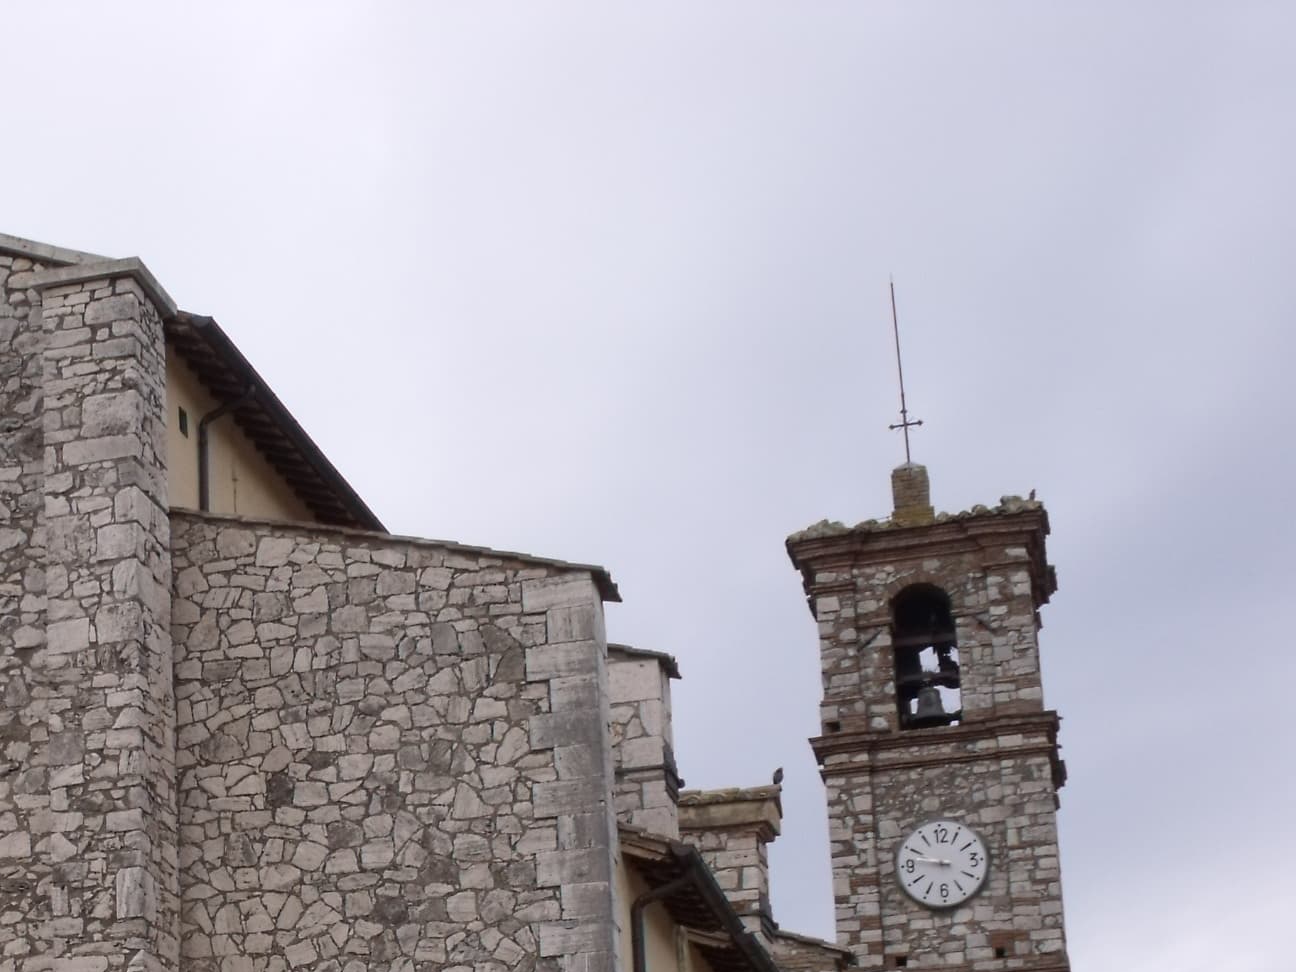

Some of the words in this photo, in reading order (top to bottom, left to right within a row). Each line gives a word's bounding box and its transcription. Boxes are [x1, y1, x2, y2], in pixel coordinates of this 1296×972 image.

[933, 828, 949, 844] 12
[905, 859, 915, 874] 9
[969, 852, 979, 868] 3
[939, 883, 950, 898] 6
